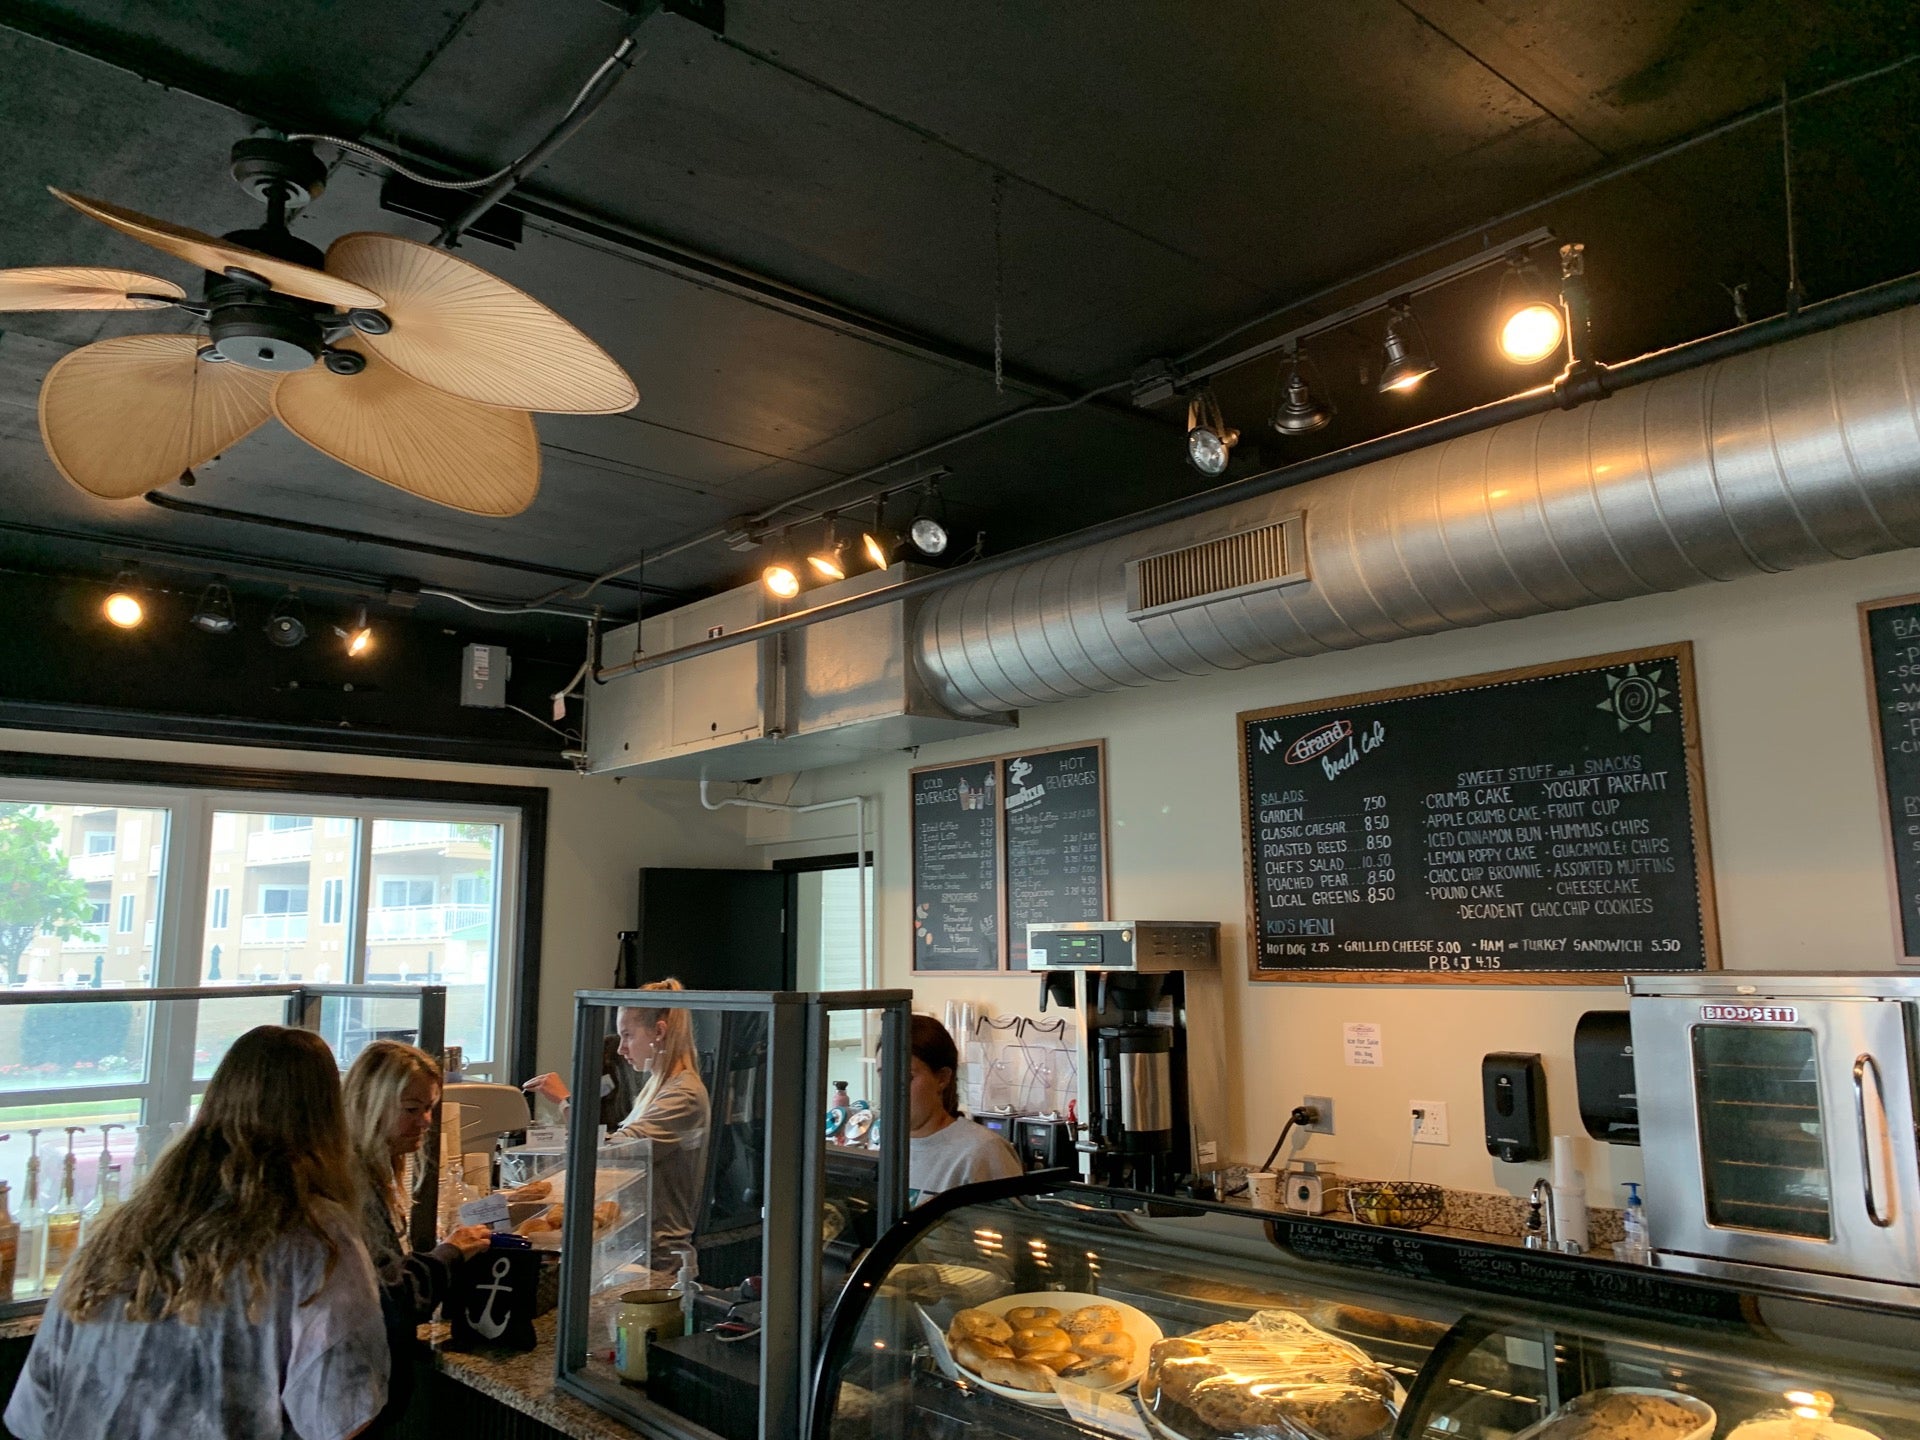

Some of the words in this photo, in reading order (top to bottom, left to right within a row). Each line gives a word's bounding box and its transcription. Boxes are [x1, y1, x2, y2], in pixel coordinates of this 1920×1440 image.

[1259, 728, 1282, 754] The
[1295, 720, 1345, 759] Grand
[1060, 757, 1086, 771] HOT
[1322, 736, 1359, 781] Beach
[1046, 770, 1096, 790] BEVERAGES
[1457, 769, 1504, 786] SWEET
[1509, 764, 1553, 781] STUFF
[1557, 764, 1575, 776] and
[1584, 755, 1642, 774] SNACKS
[923, 778, 943, 790] COLD
[1543, 778, 1600, 799] YOGURT
[1608, 771, 1668, 794] PARFAIT
[915, 788, 958, 805] BEVERAGES
[1261, 790, 1304, 805] SALADS
[1426, 791, 1470, 809] CRUMB
[1475, 787, 1513, 805] CAKE
[1260, 807, 1303, 823] GARDEN
[1427, 812, 1465, 828] APPLE
[1466, 808, 1507, 825] CRUMB
[1509, 806, 1540, 821] CAKE
[1548, 802, 1585, 818] FRUIT
[1592, 799, 1620, 815] CUP
[1261, 826, 1303, 840] CLASSIC
[1305, 821, 1346, 836] CAESAR
[1428, 832, 1455, 847] ICED
[1457, 829, 1512, 846] CINNAMON
[1516, 826, 1542, 842] BUN
[1550, 822, 1603, 840] HUMMUS
[1612, 819, 1649, 835] CHIPS
[1263, 843, 1312, 857] ROASTED
[1317, 840, 1347, 854] BEETS
[1428, 851, 1465, 865] LEMON
[1468, 848, 1501, 862] POPPY
[1506, 846, 1537, 860] CAKE
[1552, 840, 1622, 858] GUACAMOLE
[1631, 838, 1669, 854] CHIPS
[1309, 857, 1344, 871] SALAD
[1362, 853, 1391, 868] 10.50
[1553, 860, 1613, 878] ASSORTED
[1617, 857, 1675, 874] MUFFINS
[1267, 877, 1314, 891] POACHED
[1320, 873, 1348, 888] PEAR
[1368, 868, 1395, 884] 8.50
[1429, 868, 1458, 883] CHOC
[1461, 867, 1484, 882] CHIP
[1488, 863, 1544, 881] BROWNIE
[1431, 886, 1468, 900] POUND
[1471, 884, 1504, 898] CAKE
[1556, 878, 1641, 895] CHEESECAKE
[1270, 894, 1306, 908] LOCAL
[1312, 889, 1360, 905] GREENS
[1368, 887, 1395, 904] 8.50
[1460, 902, 1524, 919] DECADENT
[1595, 898, 1654, 915] COOKIES
[1267, 918, 1296, 934] KID'S
[1300, 918, 1335, 935] MENU
[1266, 943, 1284, 955] HOT
[1287, 943, 1306, 955] DOG
[1311, 942, 1329, 953] 2.75
[1344, 940, 1390, 952] GRILLED
[1392, 940, 1434, 953] CHEESE
[1437, 941, 1461, 954] 5.00
[1480, 939, 1504, 952] HAM
[1522, 938, 1567, 952] TURKEY
[1573, 939, 1642, 952] SANDWICH
[1651, 939, 1680, 952] 5.50
[1429, 956, 1450, 970] PB
[1460, 956, 1471, 970] J
[1476, 956, 1501, 969] 4.75
[1705, 1007, 1793, 1022] BLODGETT
